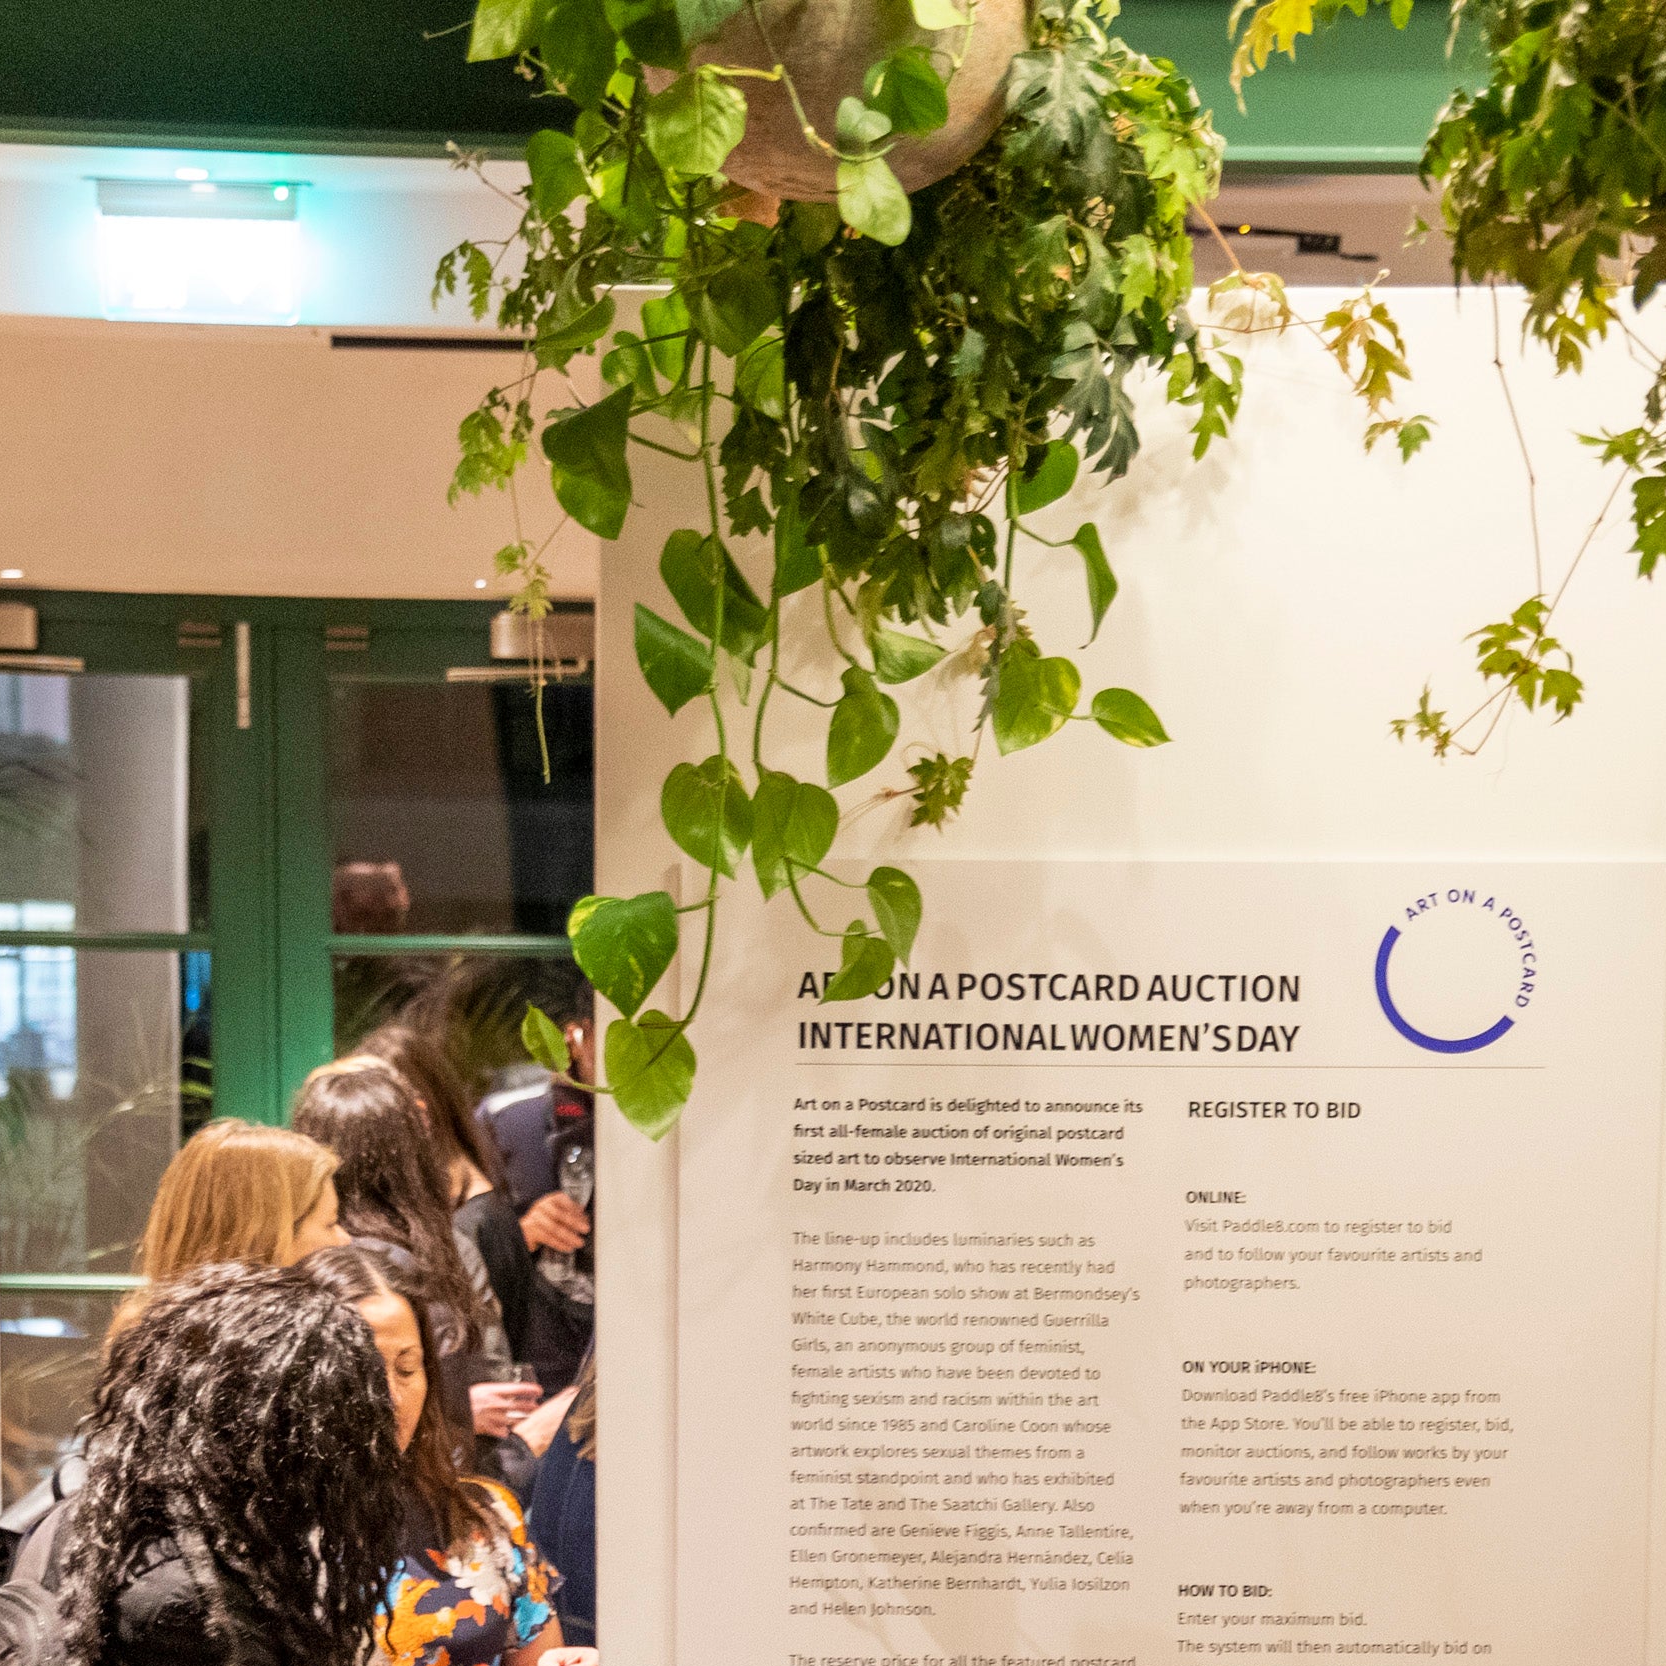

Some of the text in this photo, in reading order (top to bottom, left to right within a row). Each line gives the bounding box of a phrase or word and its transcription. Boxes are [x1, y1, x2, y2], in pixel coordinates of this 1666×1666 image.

[1405, 889, 1537, 1008] ART ON A POSTCARD
[928, 973, 950, 1000] A
[958, 973, 1139, 1002] POSTCARD
[1147, 974, 1301, 1003] AUCTION
[798, 1021, 1301, 1053] INTERNATIONAL WOMEN'S DAY
[793, 1096, 1142, 1117] Art on a Postcard is delighted to announce its
[1188, 1101, 1360, 1119] REGISTER TO BID
[792, 1123, 1124, 1144] first all-female auction of original postcard
[792, 1150, 1123, 1167] sized art to observe International Women's
[792, 1176, 936, 1195] Day in March 2020.
[1185, 1190, 1247, 1204] ONLINE:
[1184, 1217, 1452, 1236] Visit Paddle8.com to register to bid
[792, 1230, 1095, 1249] The line-up includes luminaries such as
[790, 1363, 1100, 1379] female artists who have been devoted to
[1182, 1359, 1316, 1374] ON YOUR iPHONE:
[1181, 1387, 1257, 1401] Download
[1338, 1388, 1368, 1402] free
[1373, 1388, 1426, 1402] iPhone
[1431, 1392, 1460, 1407] app
[1464, 1388, 1500, 1403] from
[789, 1416, 1111, 1432] world since 1985 and Caroline Coon whose
[789, 1443, 1085, 1462] artwork explores sexual themes from a
[789, 1469, 1115, 1488] feminist standpoint and who has exhibited
[1177, 1583, 1272, 1598] HOW TO BID:
[1177, 1611, 1367, 1629] Enter your maximum bid.
[789, 1653, 815, 1666] The
